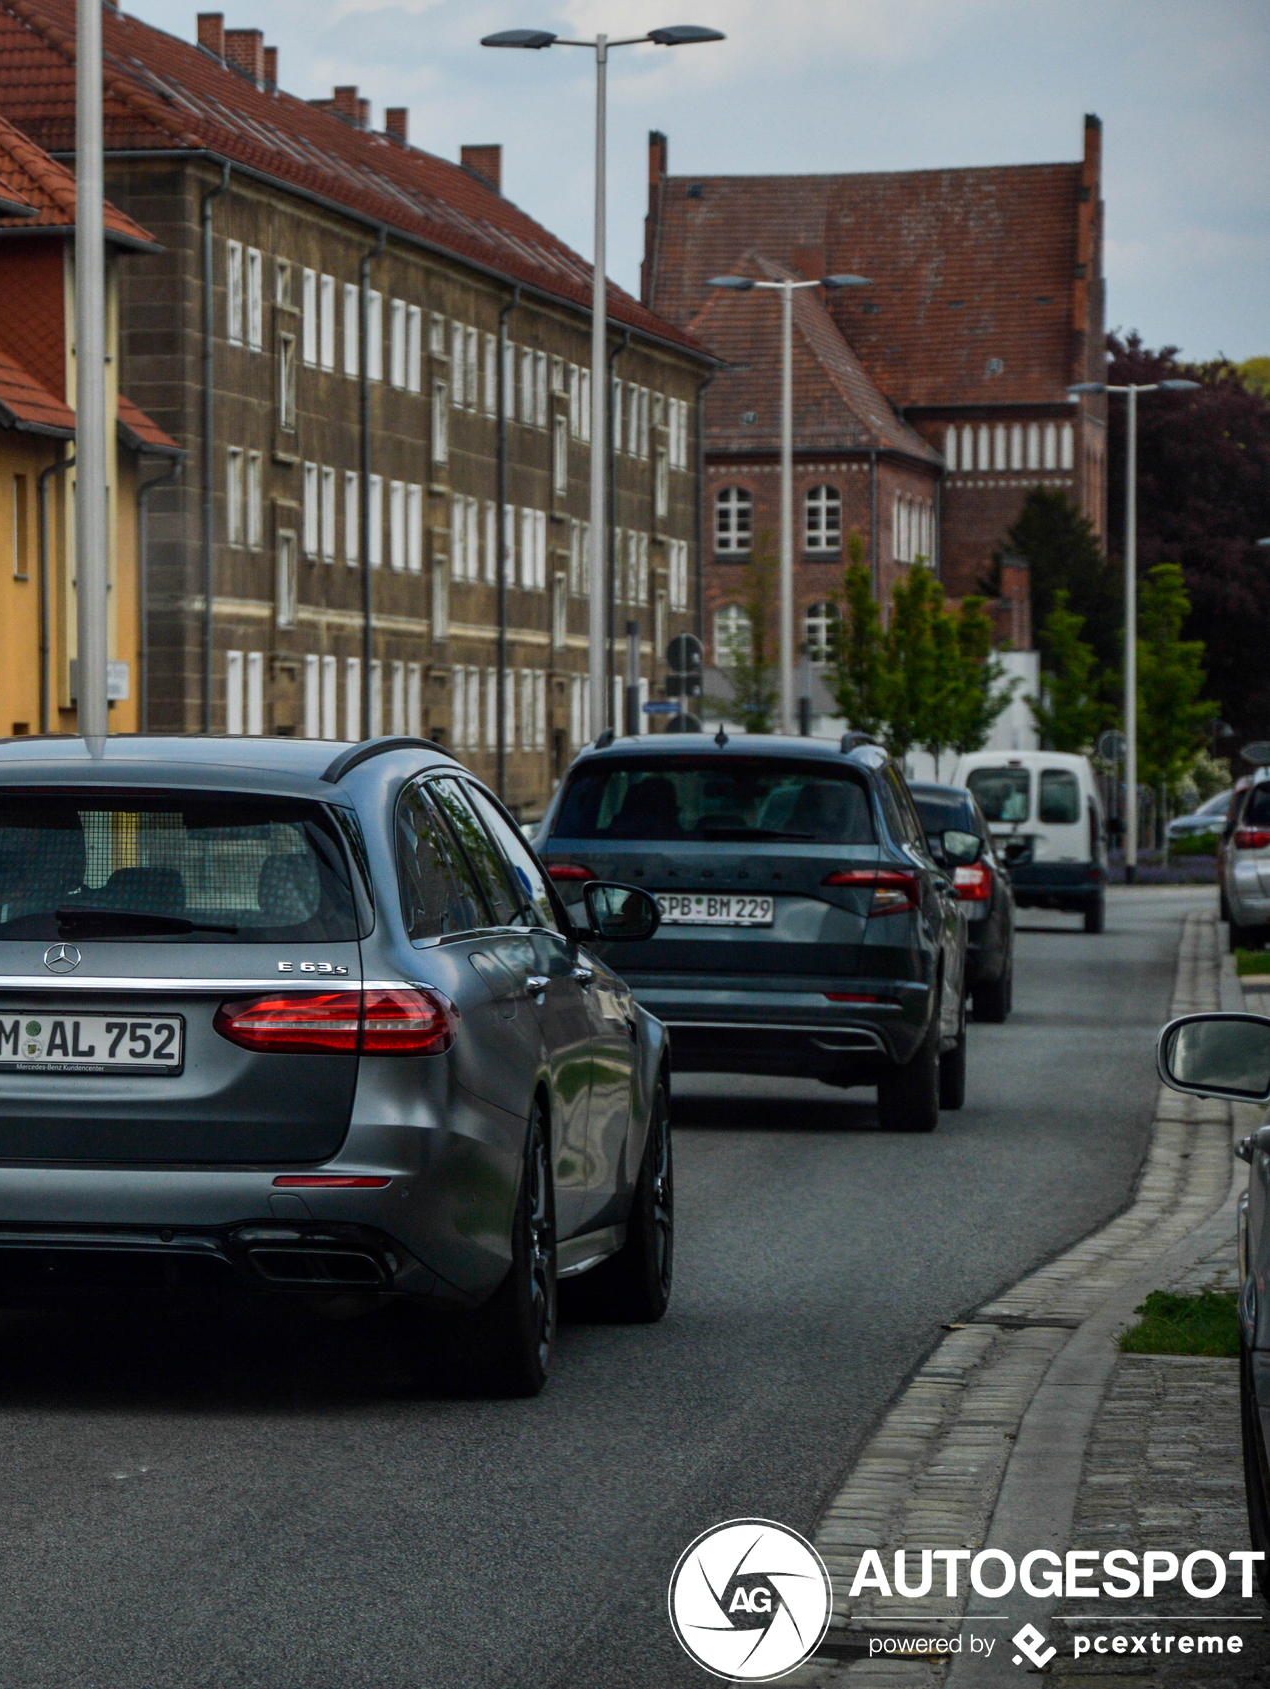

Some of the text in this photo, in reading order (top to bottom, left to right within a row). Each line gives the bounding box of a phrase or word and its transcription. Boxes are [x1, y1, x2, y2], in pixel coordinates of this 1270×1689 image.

[657, 896, 771, 919] SPB BM 229
[278, 962, 293, 972] E
[46, 1021, 95, 1058] AL
[105, 1021, 176, 1060] 752
[16, 1063, 105, 1072] Mercedes-Benz Kundencenter
